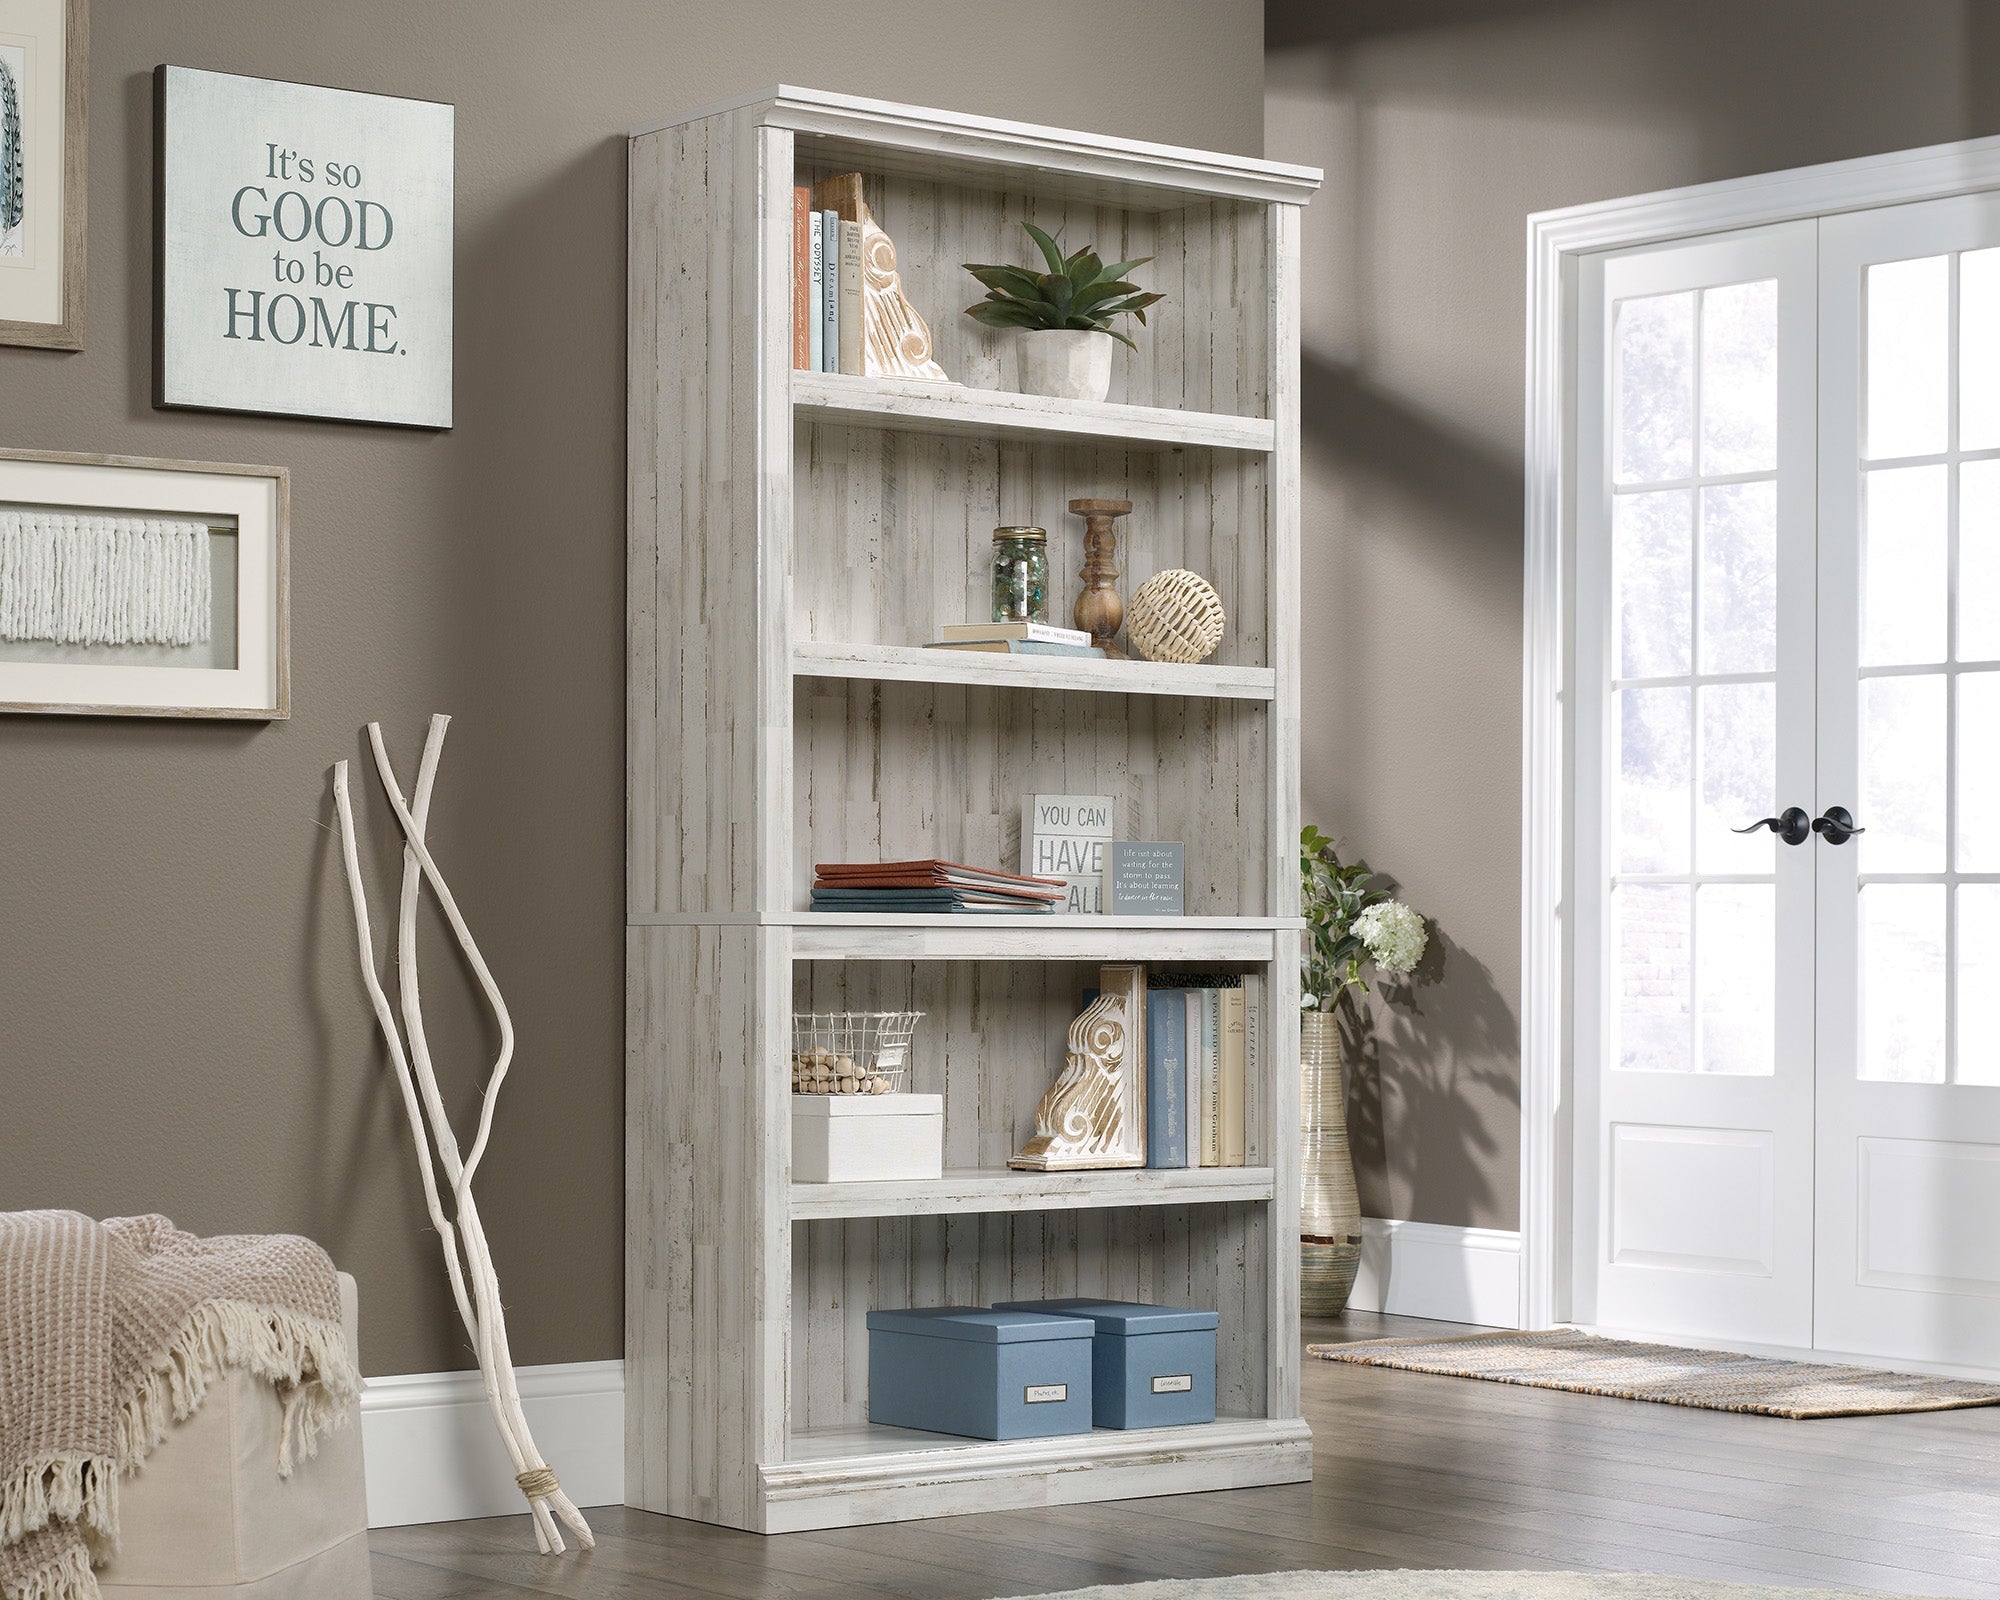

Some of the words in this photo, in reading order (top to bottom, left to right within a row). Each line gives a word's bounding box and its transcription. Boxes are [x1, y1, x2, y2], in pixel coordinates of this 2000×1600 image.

[326, 162, 361, 188] so
[232, 186, 394, 251] GOOD
[273, 250, 305, 284] to
[313, 251, 353, 289] be
[813, 243, 821, 286] ODYSSEY
[223, 288, 406, 356] HOME.
[1040, 806, 1071, 827] YOU
[1077, 807, 1106, 827] CAN
[1039, 840, 1103, 873] HAVE
[1122, 861, 1146, 870] waiting
[1148, 860, 1160, 869] for
[1162, 861, 1173, 869] the
[1152, 849, 1173, 858] about
[1067, 885, 1103, 914] ALL
[1129, 881, 1149, 889] about
[1151, 881, 1179, 890] learning
